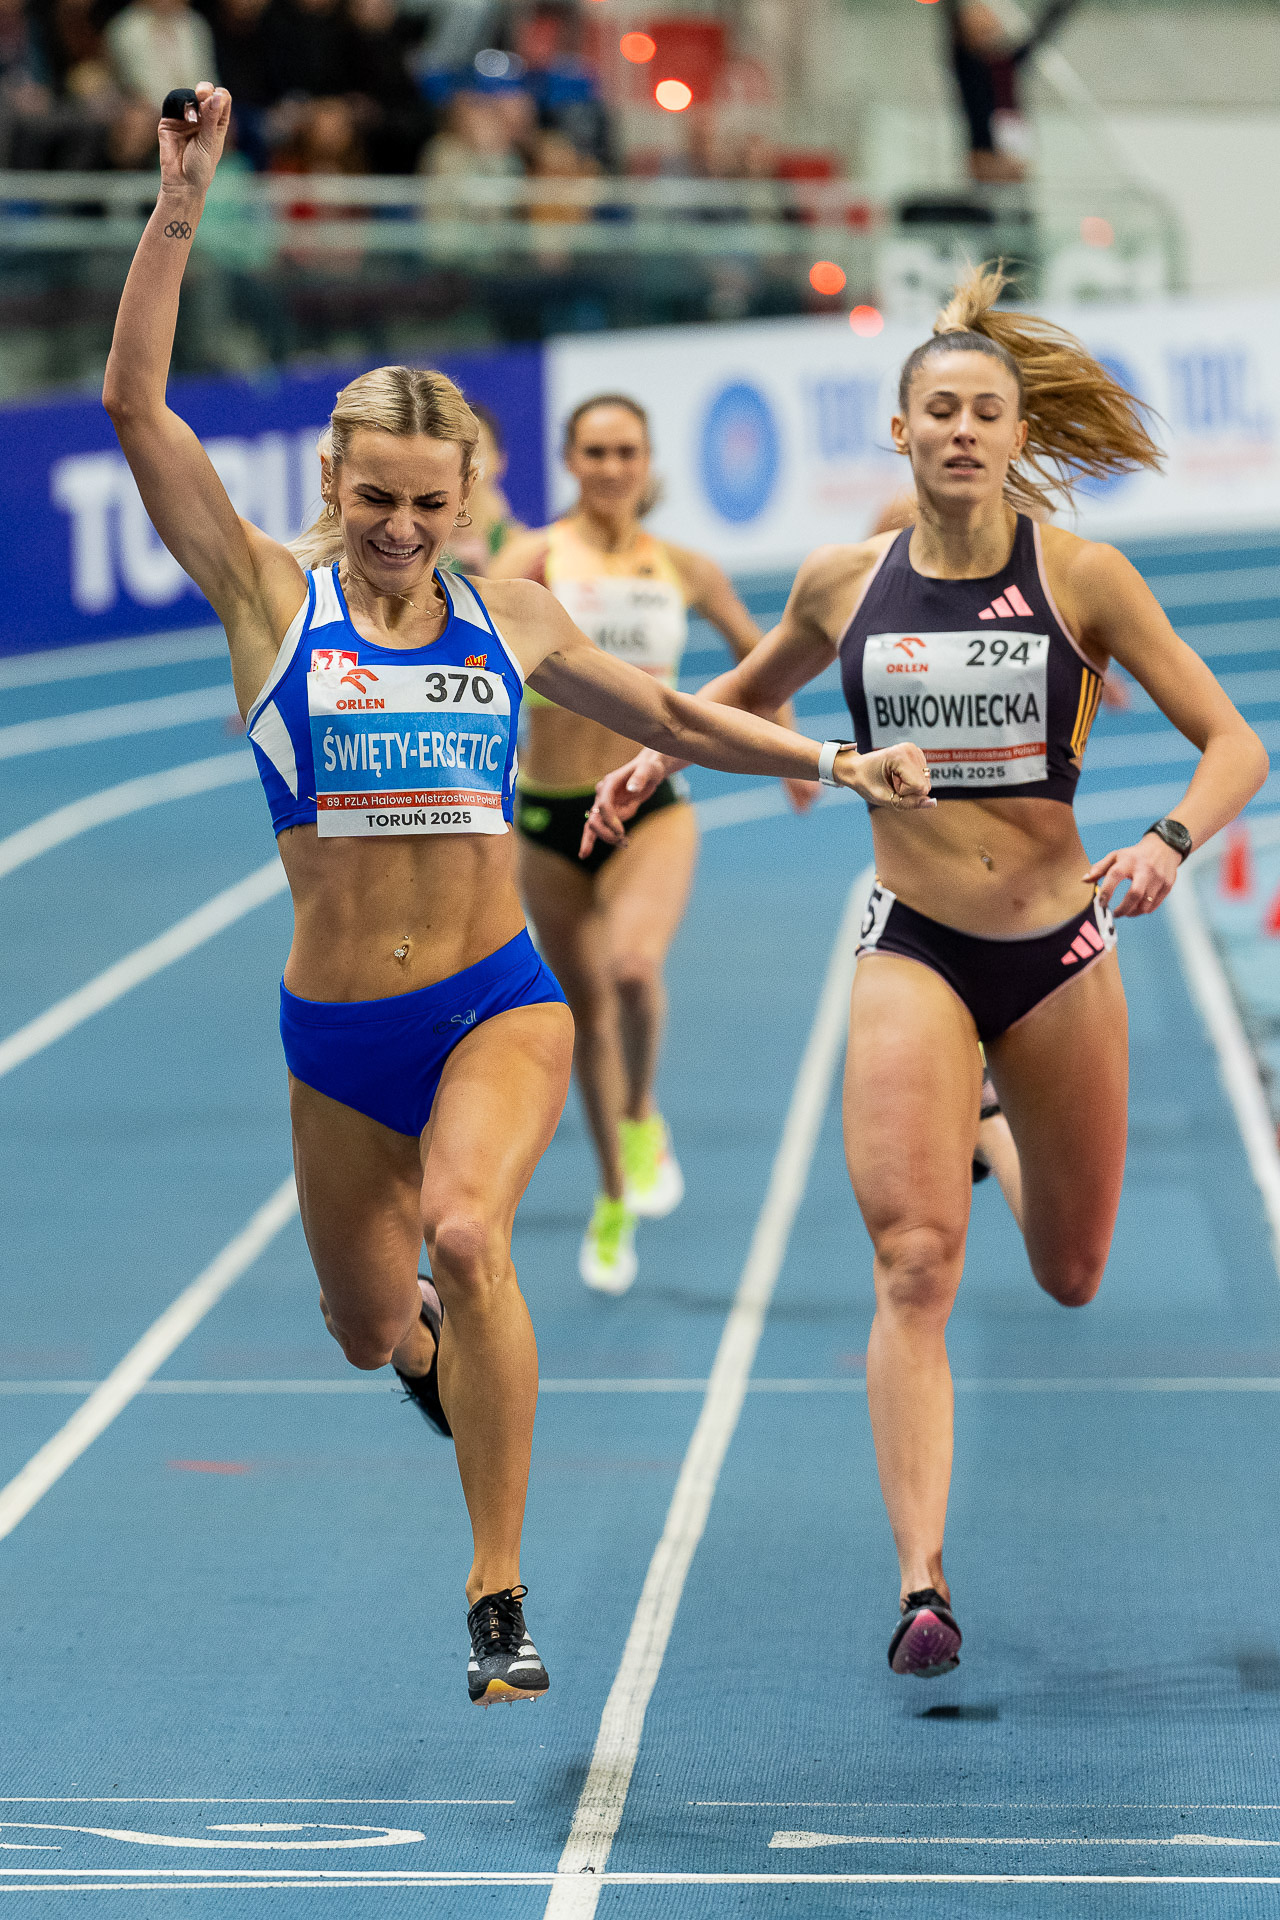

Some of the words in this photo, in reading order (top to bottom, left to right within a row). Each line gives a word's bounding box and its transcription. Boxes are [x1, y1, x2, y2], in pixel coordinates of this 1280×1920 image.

[465, 654, 487, 667] AWF
[966, 639, 1030, 667] 294
[886, 663, 929, 674] ORLEN
[425, 672, 494, 704] 370
[336, 699, 385, 710] ORLEN
[874, 692, 1040, 728] BUKOWIECKA
[322, 727, 502, 778] ŚWIĘTY-ERSETIC
[928, 764, 963, 779] RUŃ
[967, 766, 1005, 779] 2025
[326, 797, 343, 807] 69.
[344, 797, 369, 807] PZLA
[371, 794, 412, 806] Halowe
[414, 793, 476, 804] Mistrzostwa
[476, 795, 498, 806] Polski
[366, 809, 426, 828] TORUŃ
[430, 811, 472, 825] 2025
